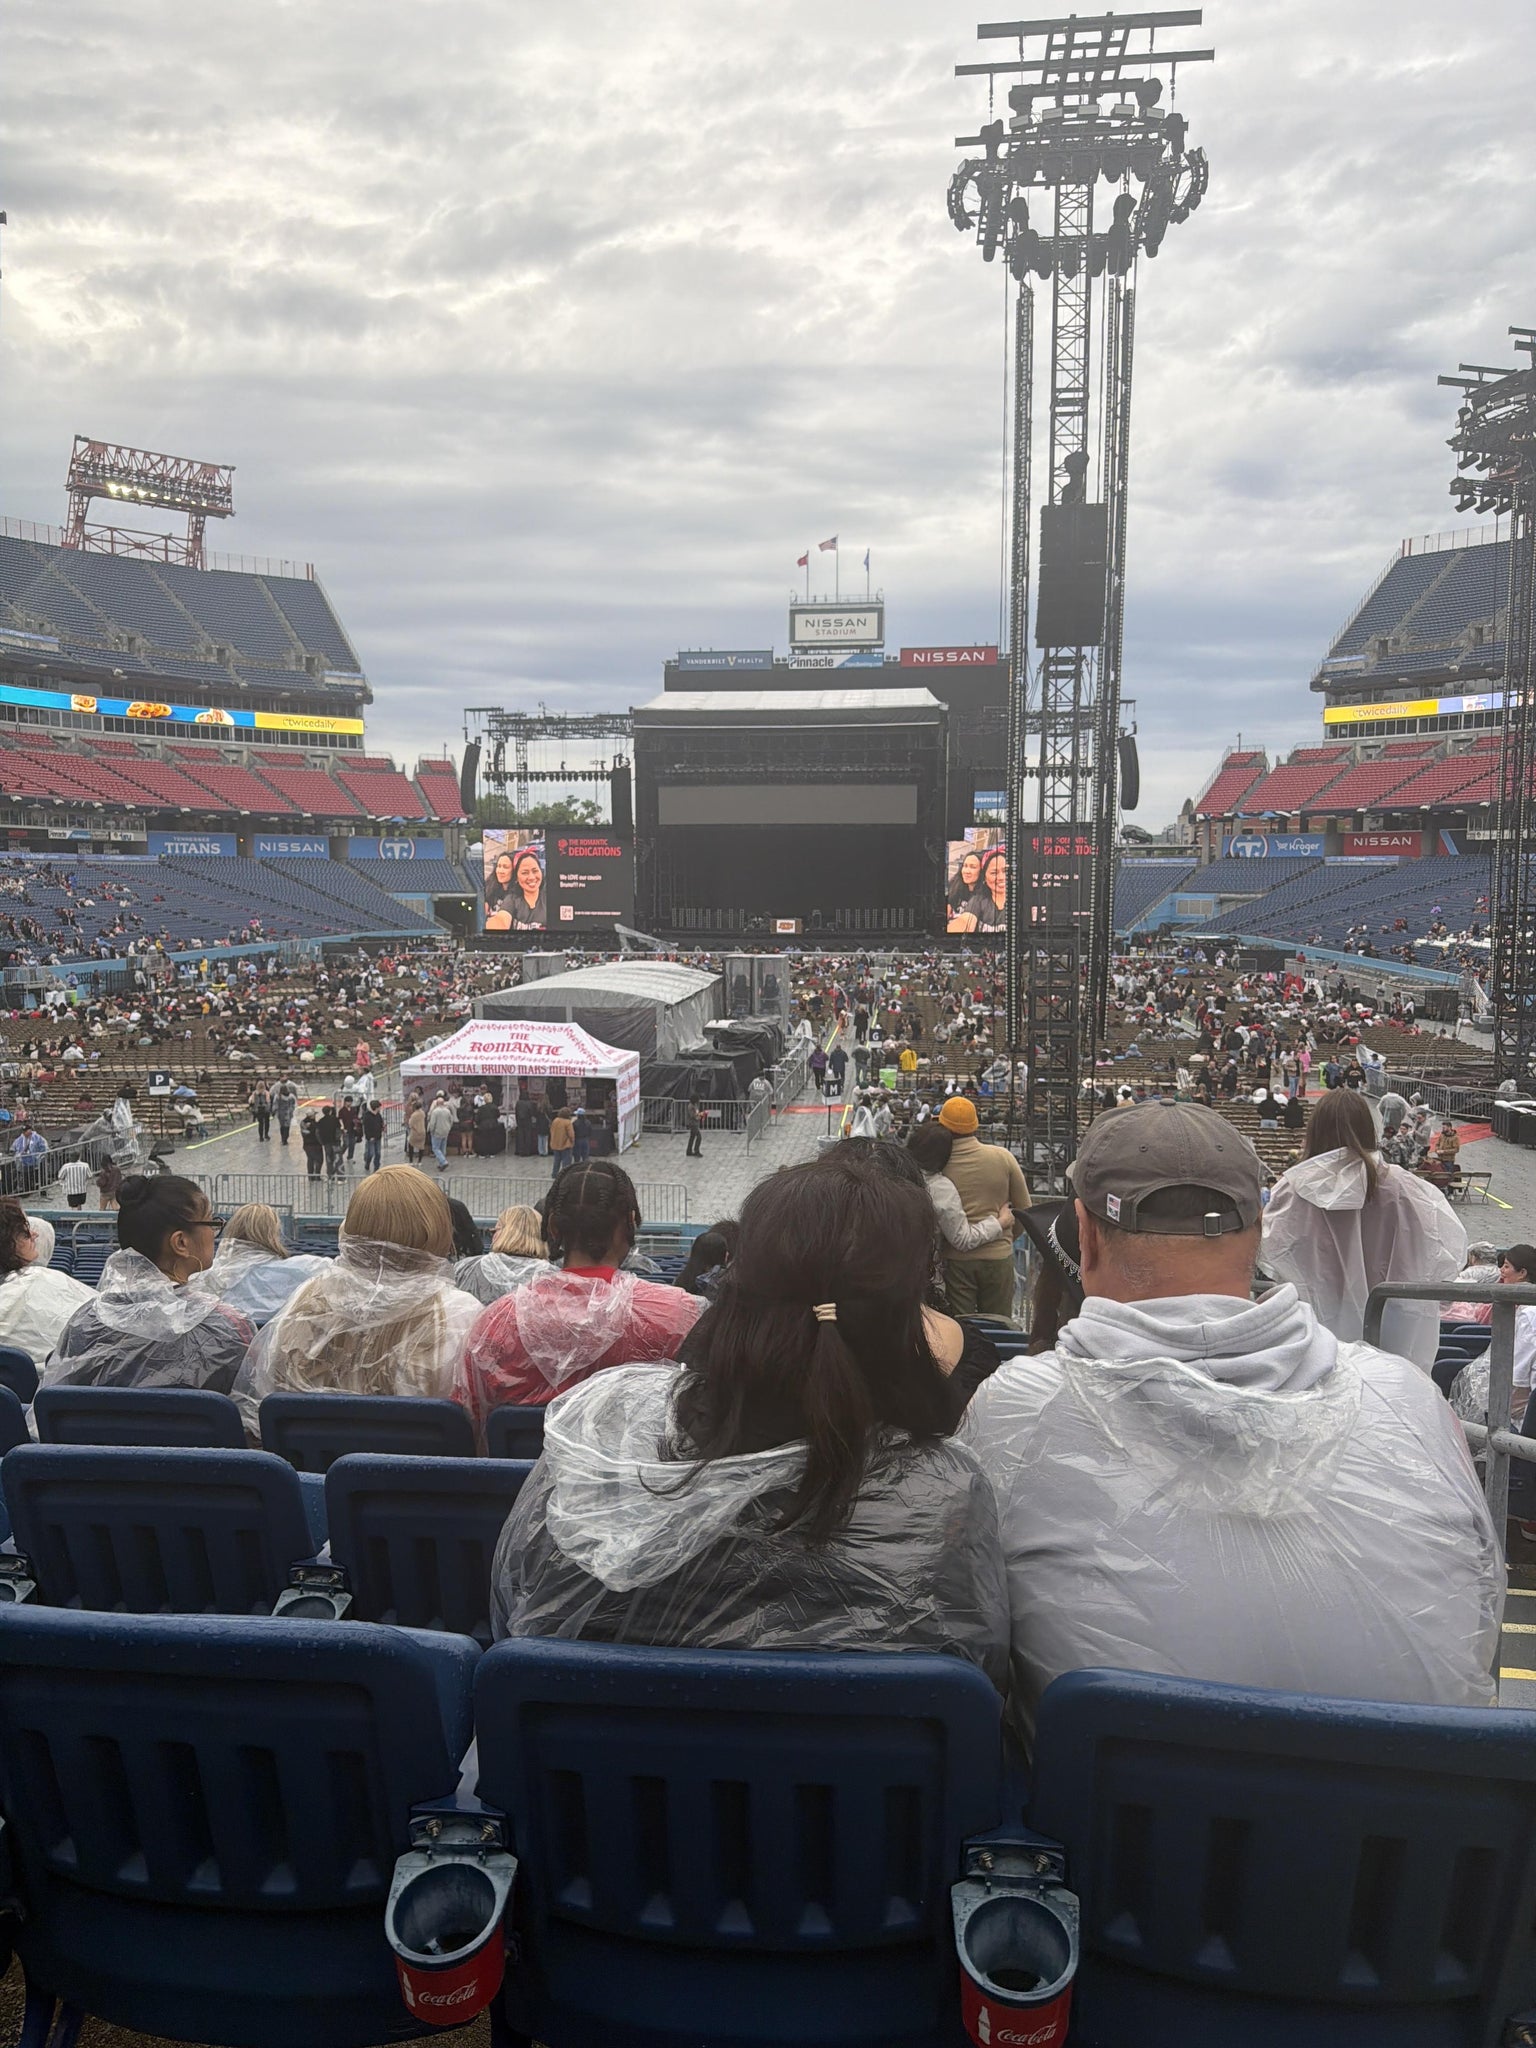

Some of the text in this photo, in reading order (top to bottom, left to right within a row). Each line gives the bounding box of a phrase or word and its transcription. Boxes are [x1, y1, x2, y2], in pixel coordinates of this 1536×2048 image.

[805, 618, 867, 628] NISSAN
[815, 628, 856, 636] STADIUM
[789, 656, 834, 668] Pinnacle
[913, 651, 985, 663] NISSAN
[260, 841, 325, 853] NISSAN
[1289, 837, 1320, 856] Kroger
[1353, 836, 1412, 847] NISSAN
[164, 842, 221, 854] TITANS
[568, 847, 621, 856] DEDICATIONS
[510, 1032, 530, 1041] THE
[872, 1031, 879, 1041] G
[470, 1041, 564, 1056] ROMANTIC
[431, 1063, 586, 1076] OFFICIAL BRUNO MARS MERCH
[155, 1074, 164, 1085] P
[830, 1084, 838, 1096] M
